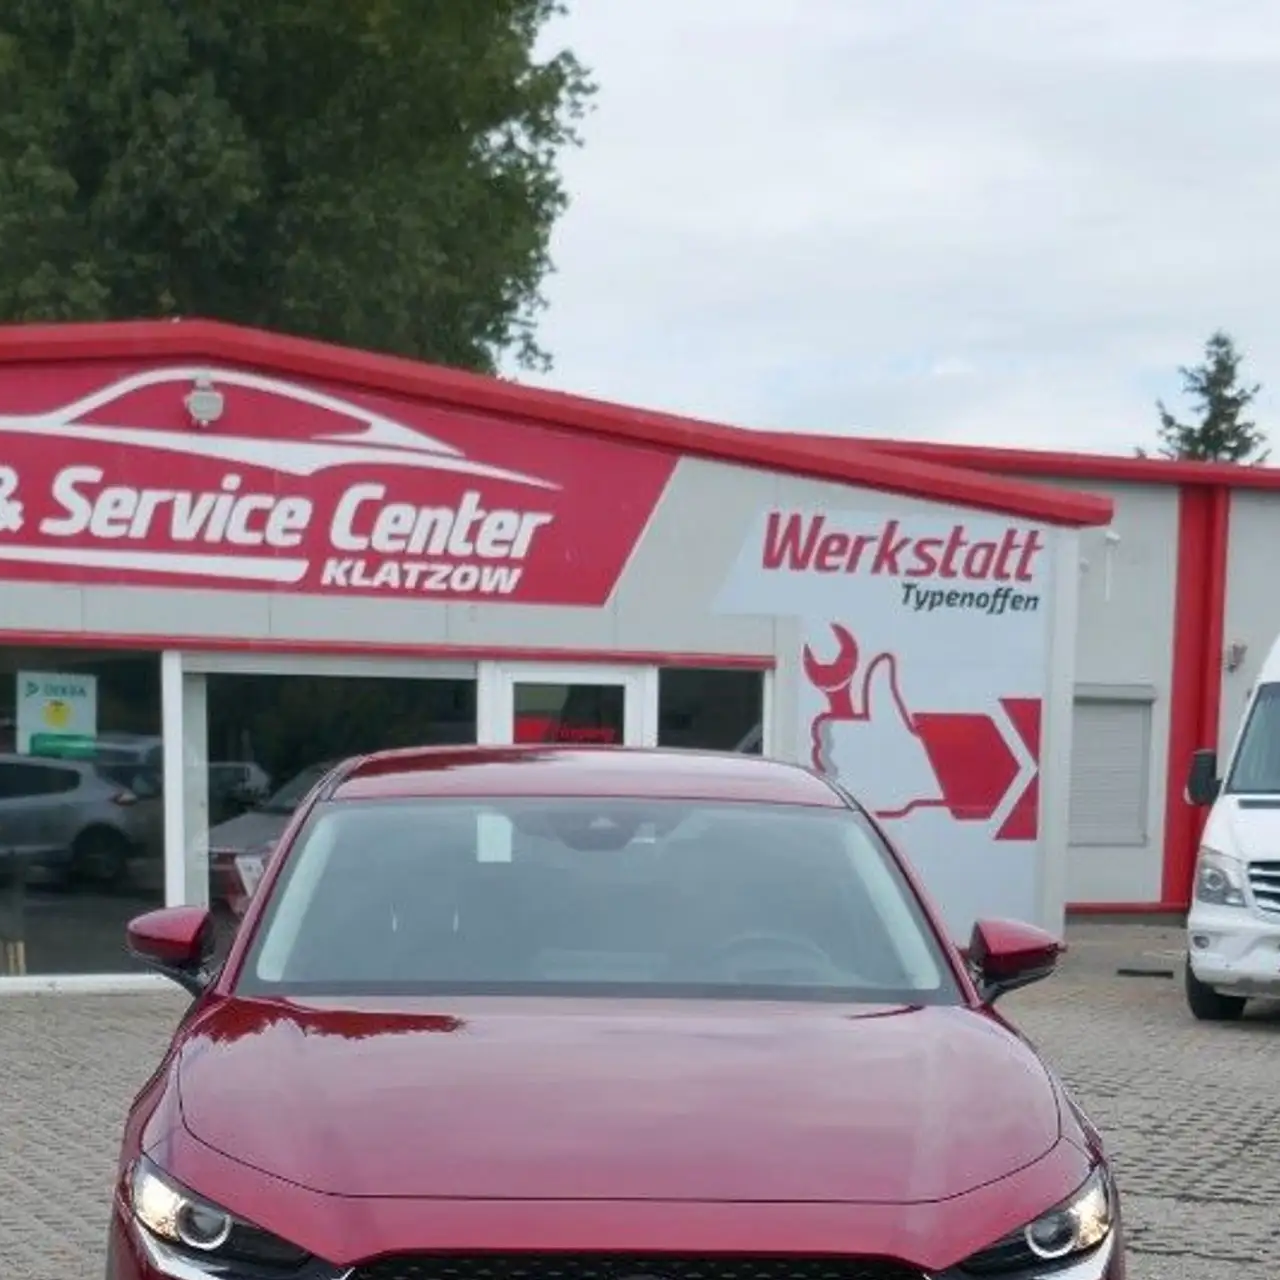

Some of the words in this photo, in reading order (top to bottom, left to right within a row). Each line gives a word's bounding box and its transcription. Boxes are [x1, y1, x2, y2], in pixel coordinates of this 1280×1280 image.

[39, 464, 313, 548] Service
[330, 482, 554, 560] Center
[762, 511, 1044, 582] Werkstatt
[321, 558, 523, 595] KLATZOW
[901, 582, 1040, 615] Typenoffen
